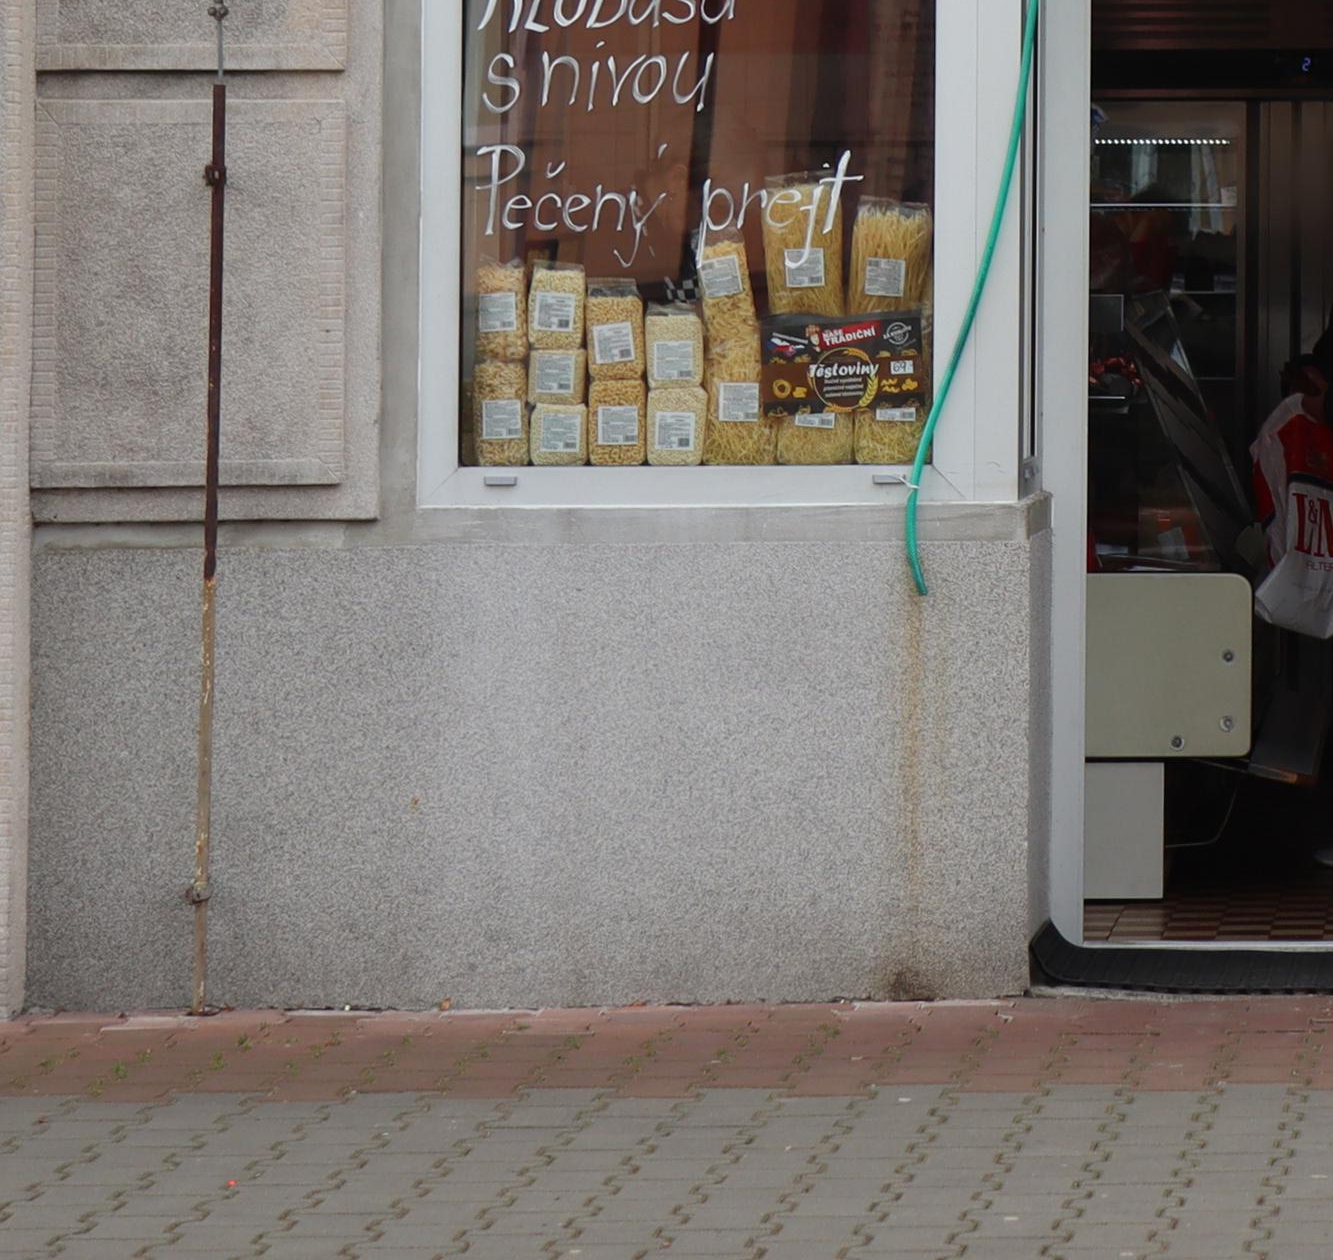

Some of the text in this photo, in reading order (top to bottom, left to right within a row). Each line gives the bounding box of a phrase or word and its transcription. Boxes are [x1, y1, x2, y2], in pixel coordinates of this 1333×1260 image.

[475, 144, 865, 270] Pečený prejt
[823, 326, 876, 346] TRADIČNÍ
[808, 361, 880, 379] Těstoviny
